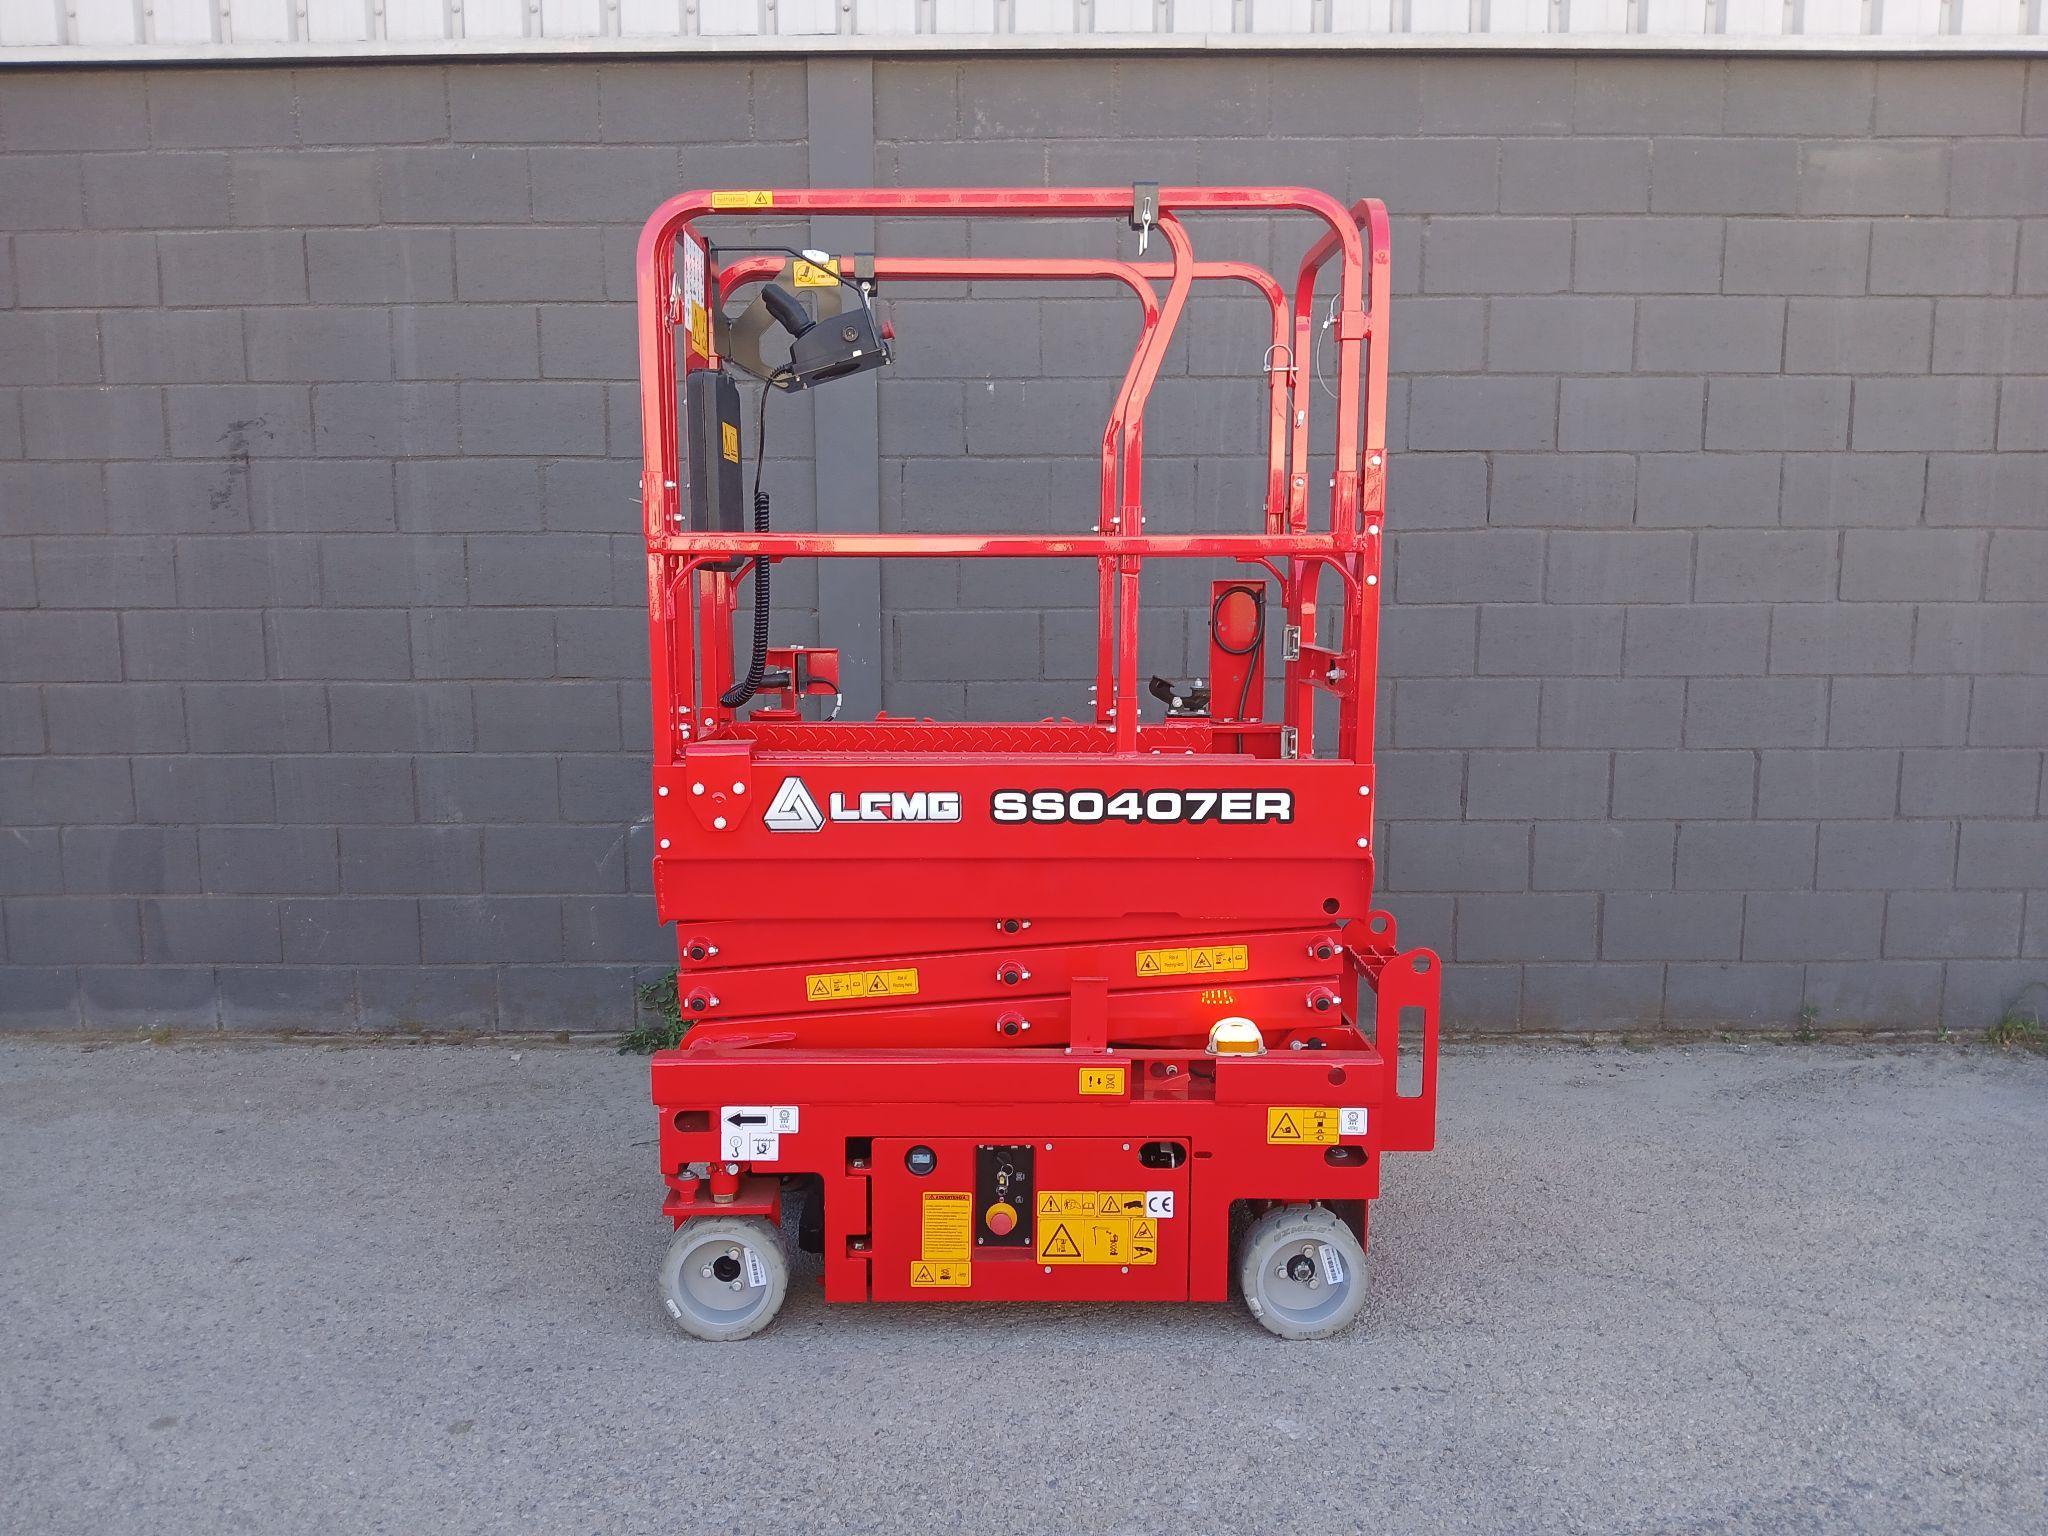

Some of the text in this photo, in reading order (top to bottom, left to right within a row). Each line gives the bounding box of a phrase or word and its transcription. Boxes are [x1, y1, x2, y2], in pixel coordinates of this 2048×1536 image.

[829, 791, 961, 822] LGMG
[992, 791, 1291, 821] SS0407ER
[1148, 1197, 1171, 1212] CE
